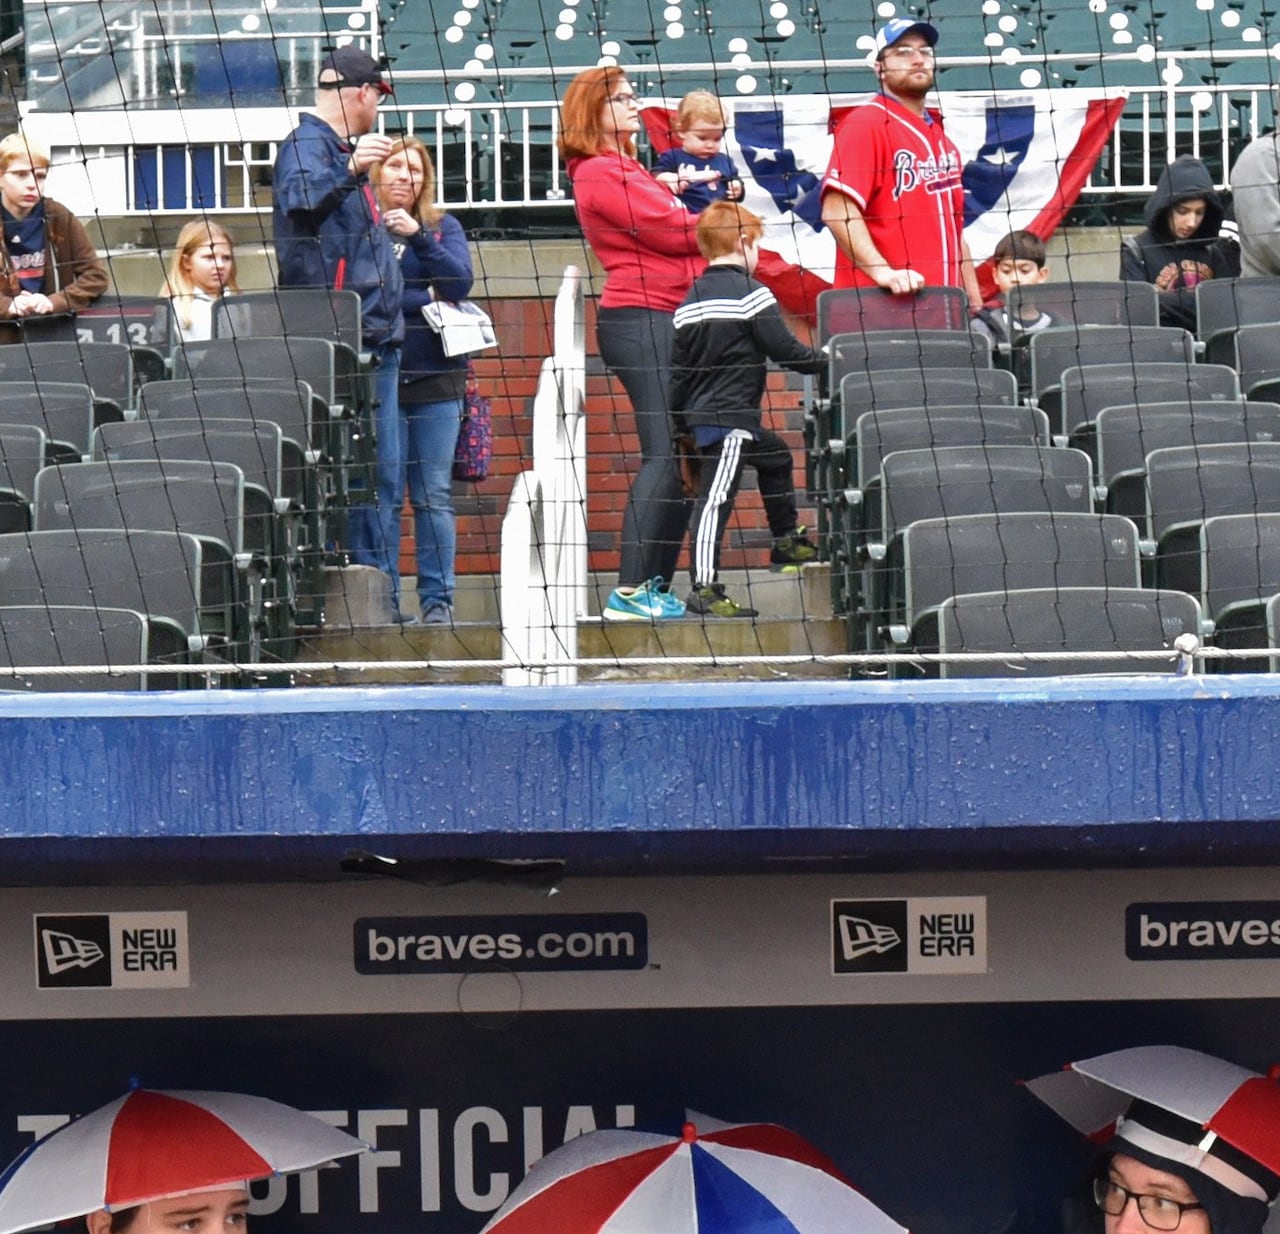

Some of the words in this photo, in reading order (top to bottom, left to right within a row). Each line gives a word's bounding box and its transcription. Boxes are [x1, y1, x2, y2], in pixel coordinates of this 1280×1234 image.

[107, 322, 157, 345] 13
[920, 914, 975, 935] NEW
[122, 929, 176, 949] NEW
[368, 929, 634, 963] braves.com
[920, 938, 975, 957] ERA
[123, 951, 177, 971] ERA
